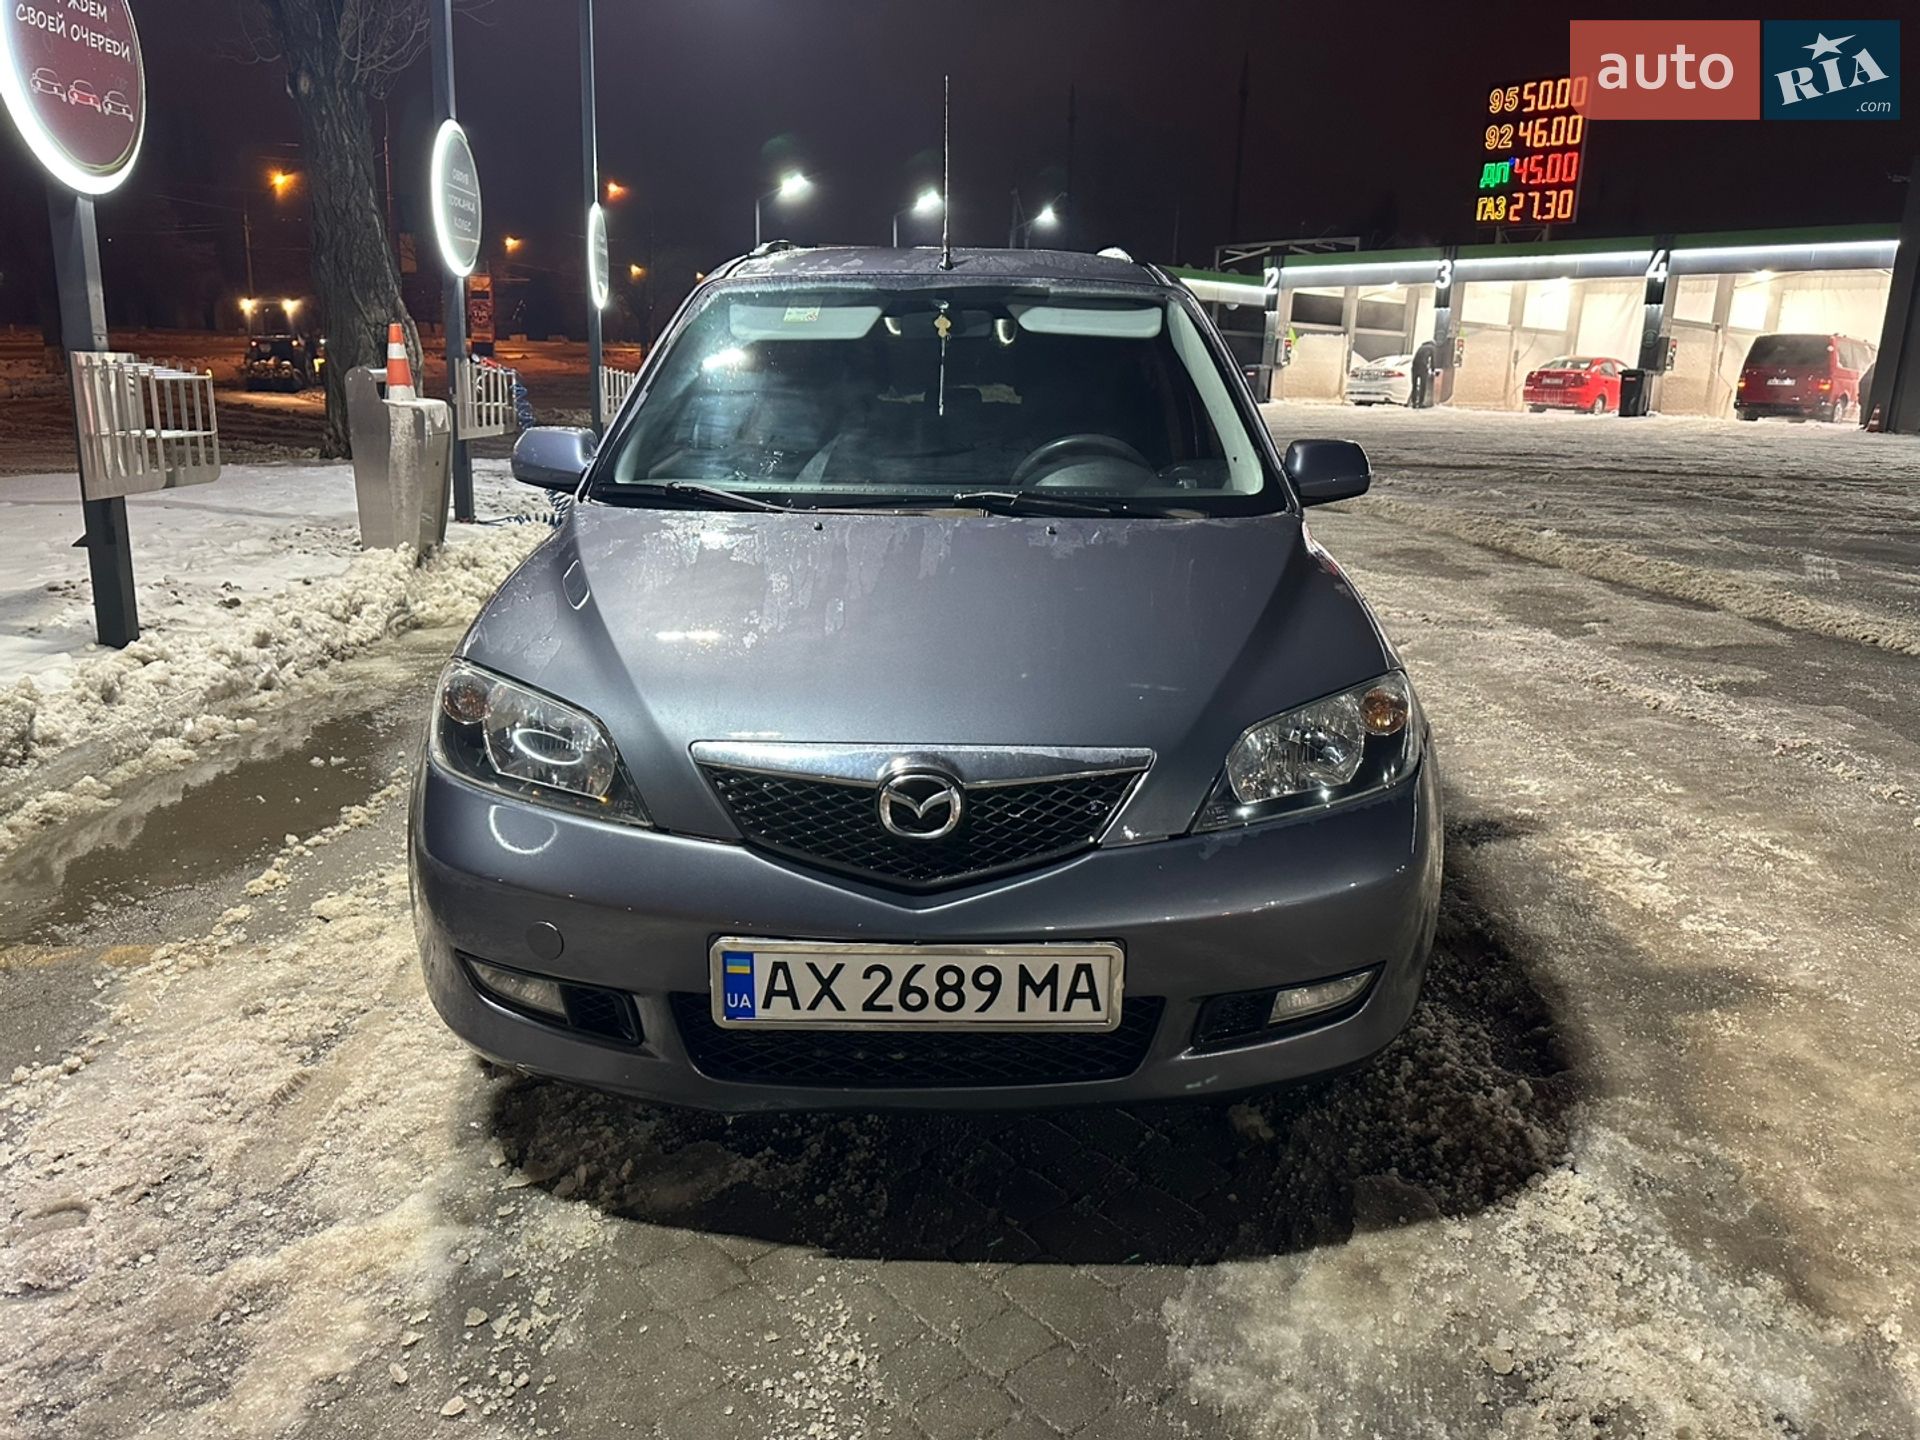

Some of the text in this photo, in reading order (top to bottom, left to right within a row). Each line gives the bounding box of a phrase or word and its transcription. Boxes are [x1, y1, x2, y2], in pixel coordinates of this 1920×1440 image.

[16, 4, 131, 62] СВОЕЙ ОЧЕРЕДИ
[1489, 76, 1589, 114] 95 50.00
[1485, 114, 1583, 150] 92 46.00
[1513, 151, 1579, 185] 45.00
[1475, 189, 1574, 222] ГАЗ 27.30
[1264, 267, 1280, 294] 2
[1435, 259, 1452, 289] 3
[1645, 249, 1668, 283] 4
[726, 993, 752, 1009] UA
[761, 961, 1103, 1013] AX 2689 MA
